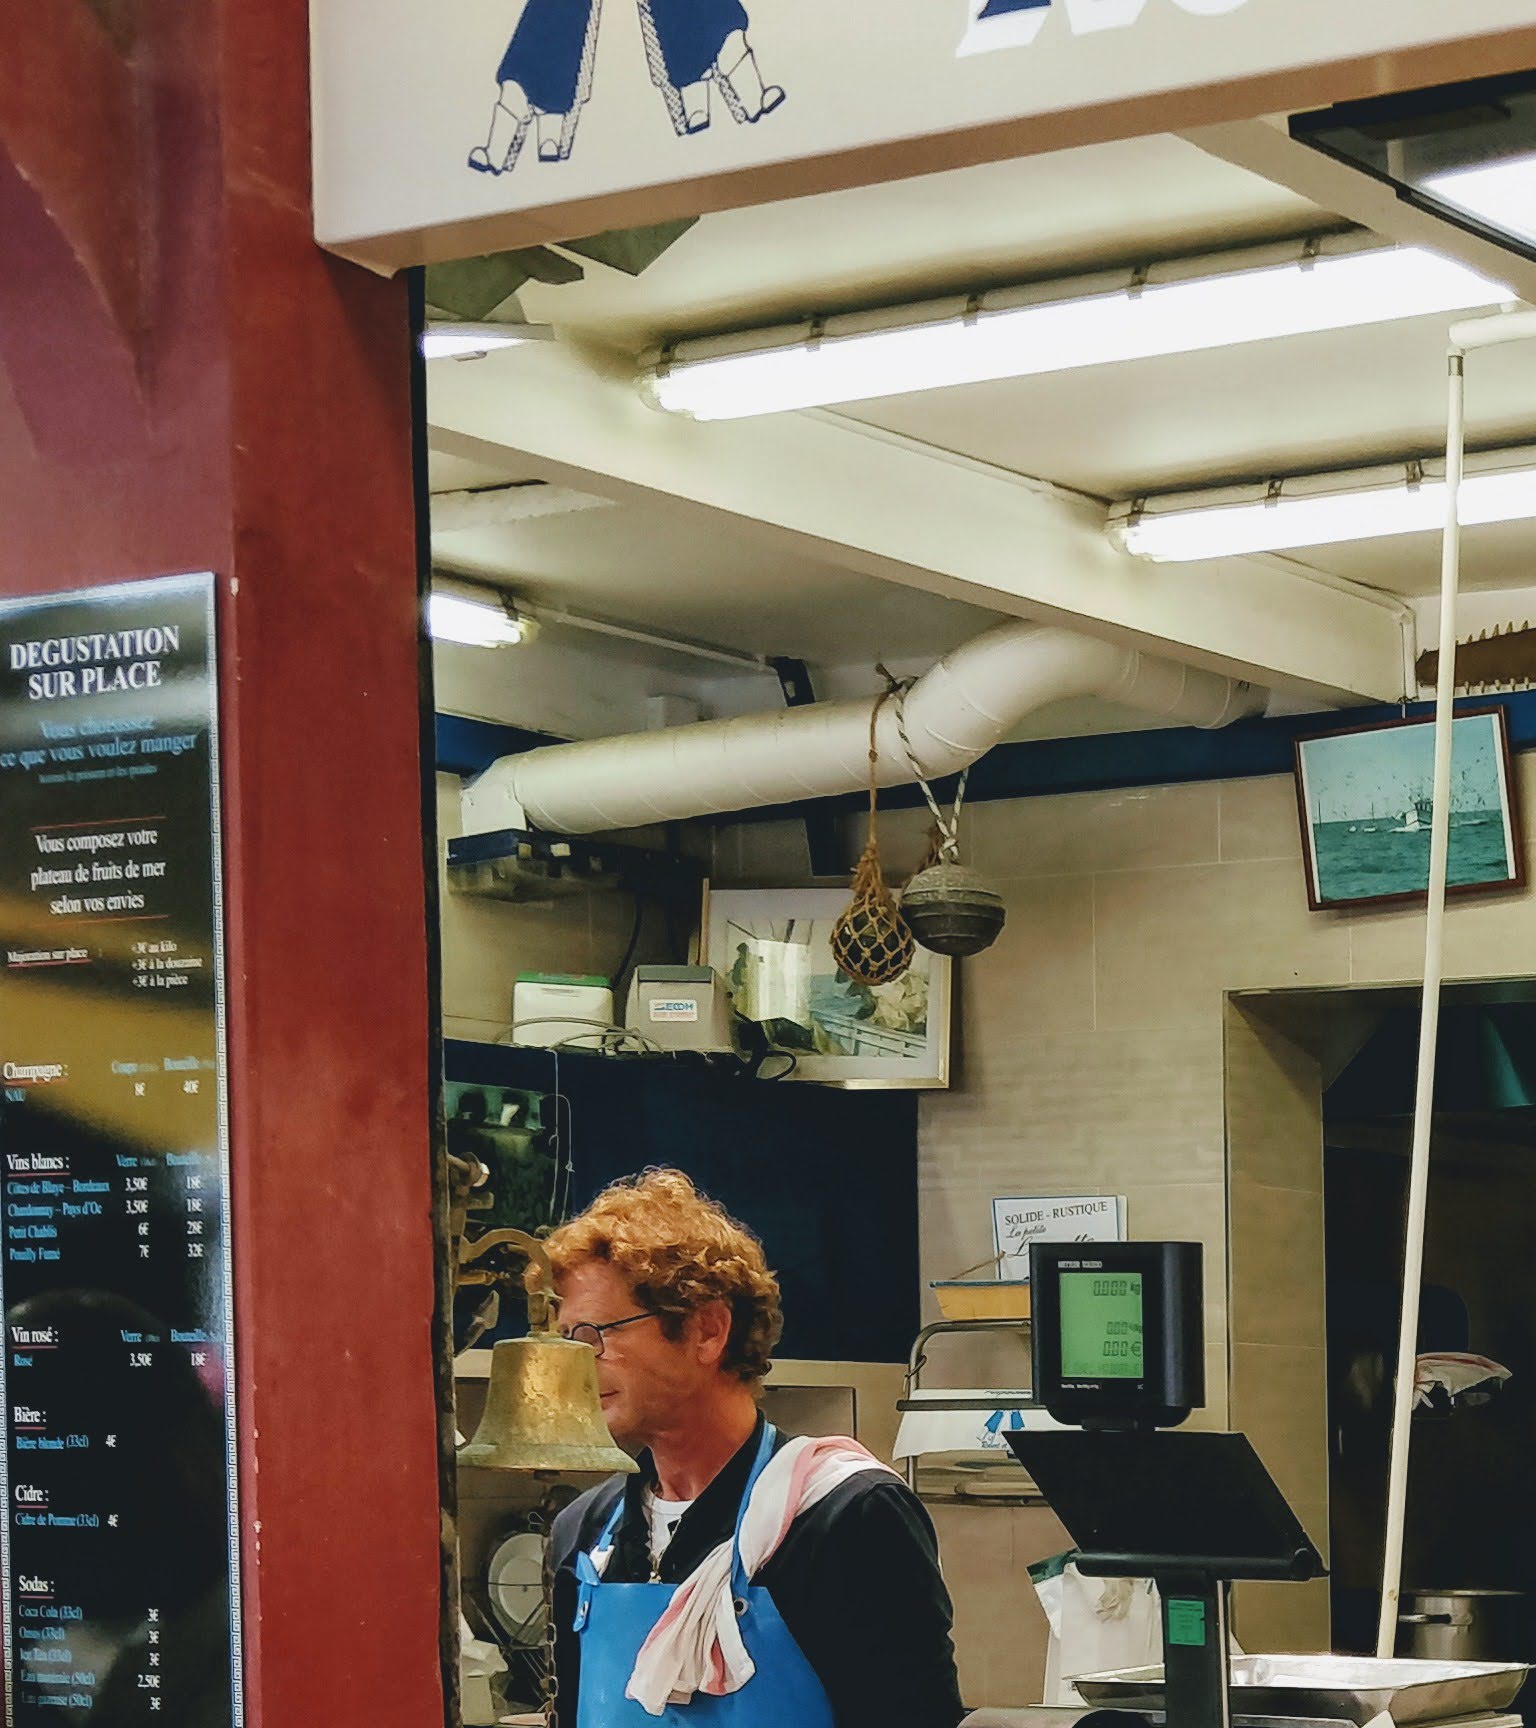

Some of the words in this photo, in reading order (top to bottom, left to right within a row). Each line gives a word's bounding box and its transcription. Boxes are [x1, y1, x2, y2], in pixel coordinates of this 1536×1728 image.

[10, 625, 180, 671] DEGUSTATION
[29, 671, 76, 700] SUR
[82, 661, 162, 695] PLACE
[50, 745, 84, 763] vous
[88, 740, 137, 758] voulez
[141, 732, 197, 754] manger
[36, 833, 64, 853] Vous
[66, 832, 124, 857] composez
[127, 828, 157, 847] votre
[31, 867, 72, 891] plateau
[75, 864, 89, 883] de
[91, 858, 122, 880] fruits
[124, 859, 139, 877] de
[142, 859, 166, 877] mer
[50, 894, 81, 916] selon
[84, 895, 105, 912] vos
[107, 889, 144, 911] envies
[7, 1154, 29, 1170] Vins
[31, 1153, 64, 1169] blancs
[1004, 1209, 1044, 1226] SOLIDE
[1052, 1200, 1108, 1220] RUSTIQUE
[11, 1327, 31, 1345] Vin
[33, 1327, 53, 1344] rosé
[13, 1406, 39, 1425] Bière
[15, 1485, 43, 1502] Cidre
[18, 1575, 49, 1593] Sodas
